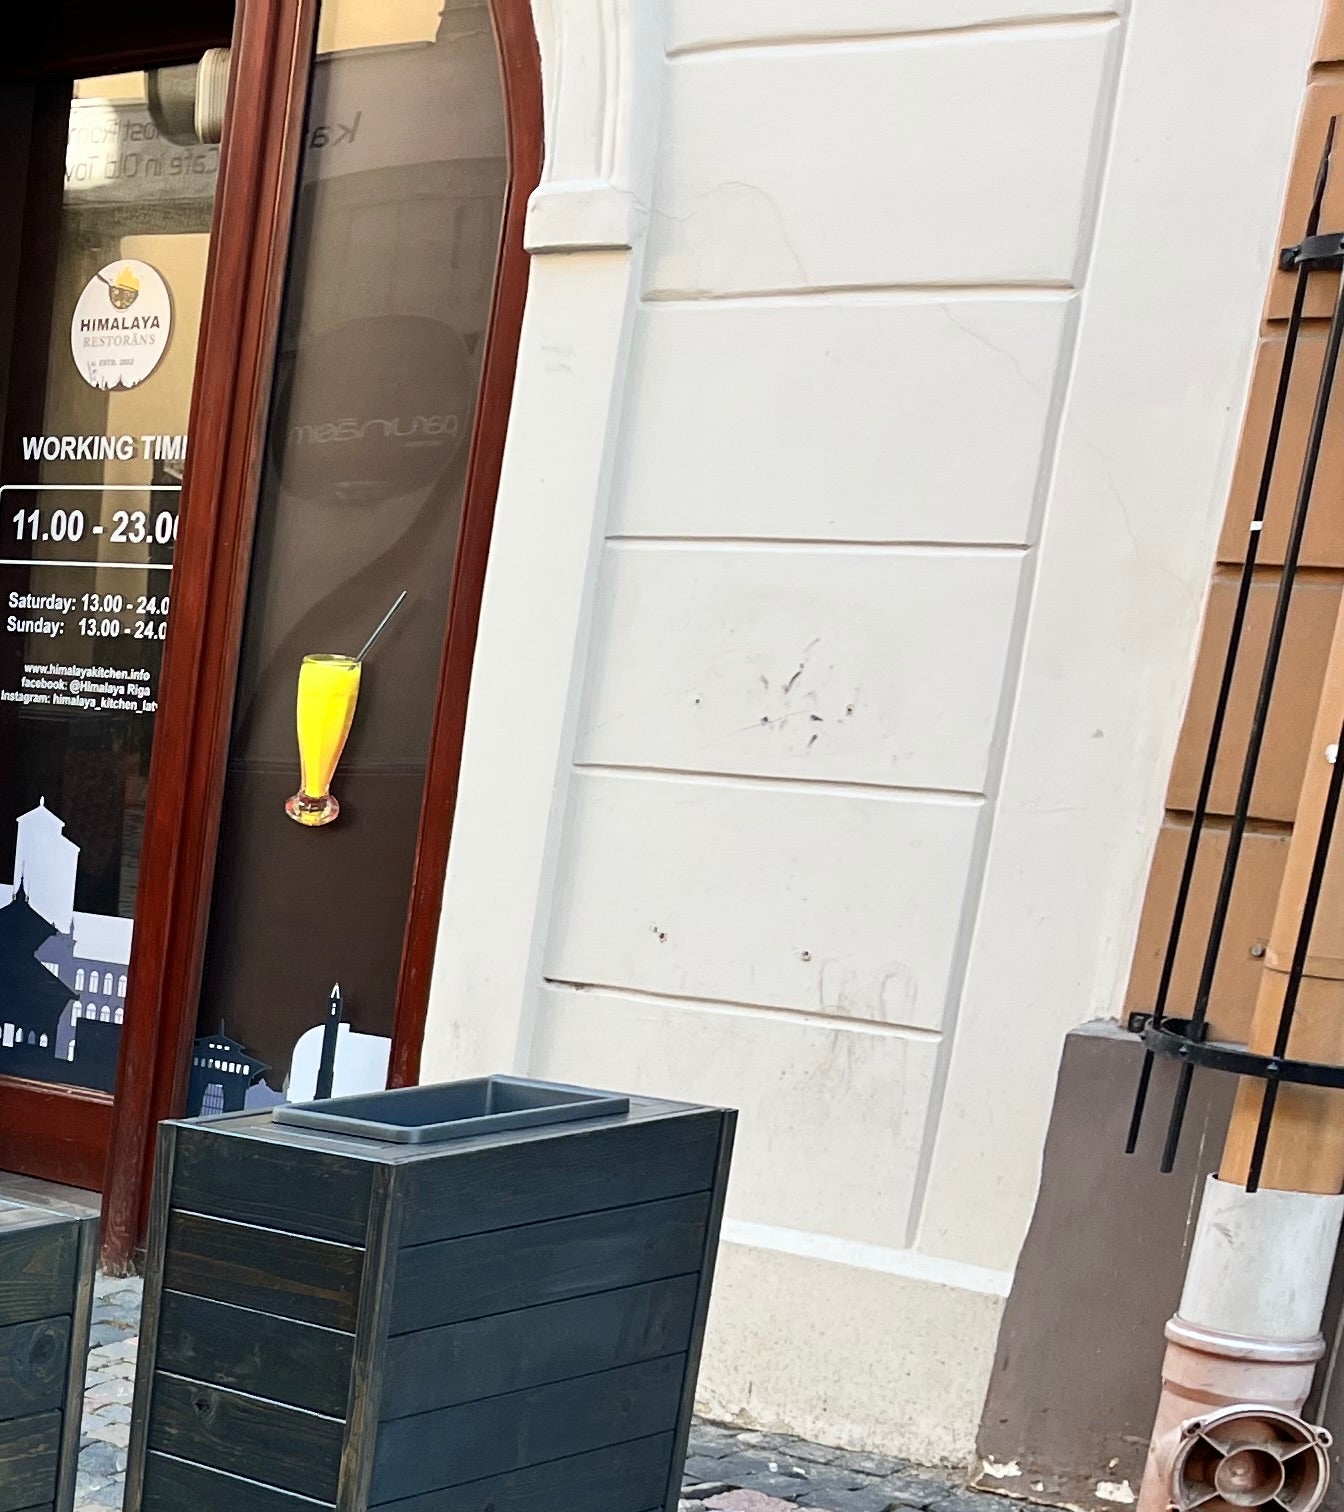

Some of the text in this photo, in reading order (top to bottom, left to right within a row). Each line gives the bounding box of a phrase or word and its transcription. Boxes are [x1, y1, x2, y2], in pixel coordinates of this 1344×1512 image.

[80, 316, 160, 331] HIMALAYA
[83, 333, 156, 347] RESTORĀNS
[22, 435, 135, 461] WORKING
[13, 509, 84, 541] 11.00
[8, 592, 76, 614] Saturday:
[81, 594, 122, 613] 13.00
[7, 616, 64, 637] Sunday:
[78, 618, 120, 637] 13.00
[24, 663, 151, 682] www.himalayakitchen.info
[21, 677, 151, 697] facebook: @Himalaya Riga
